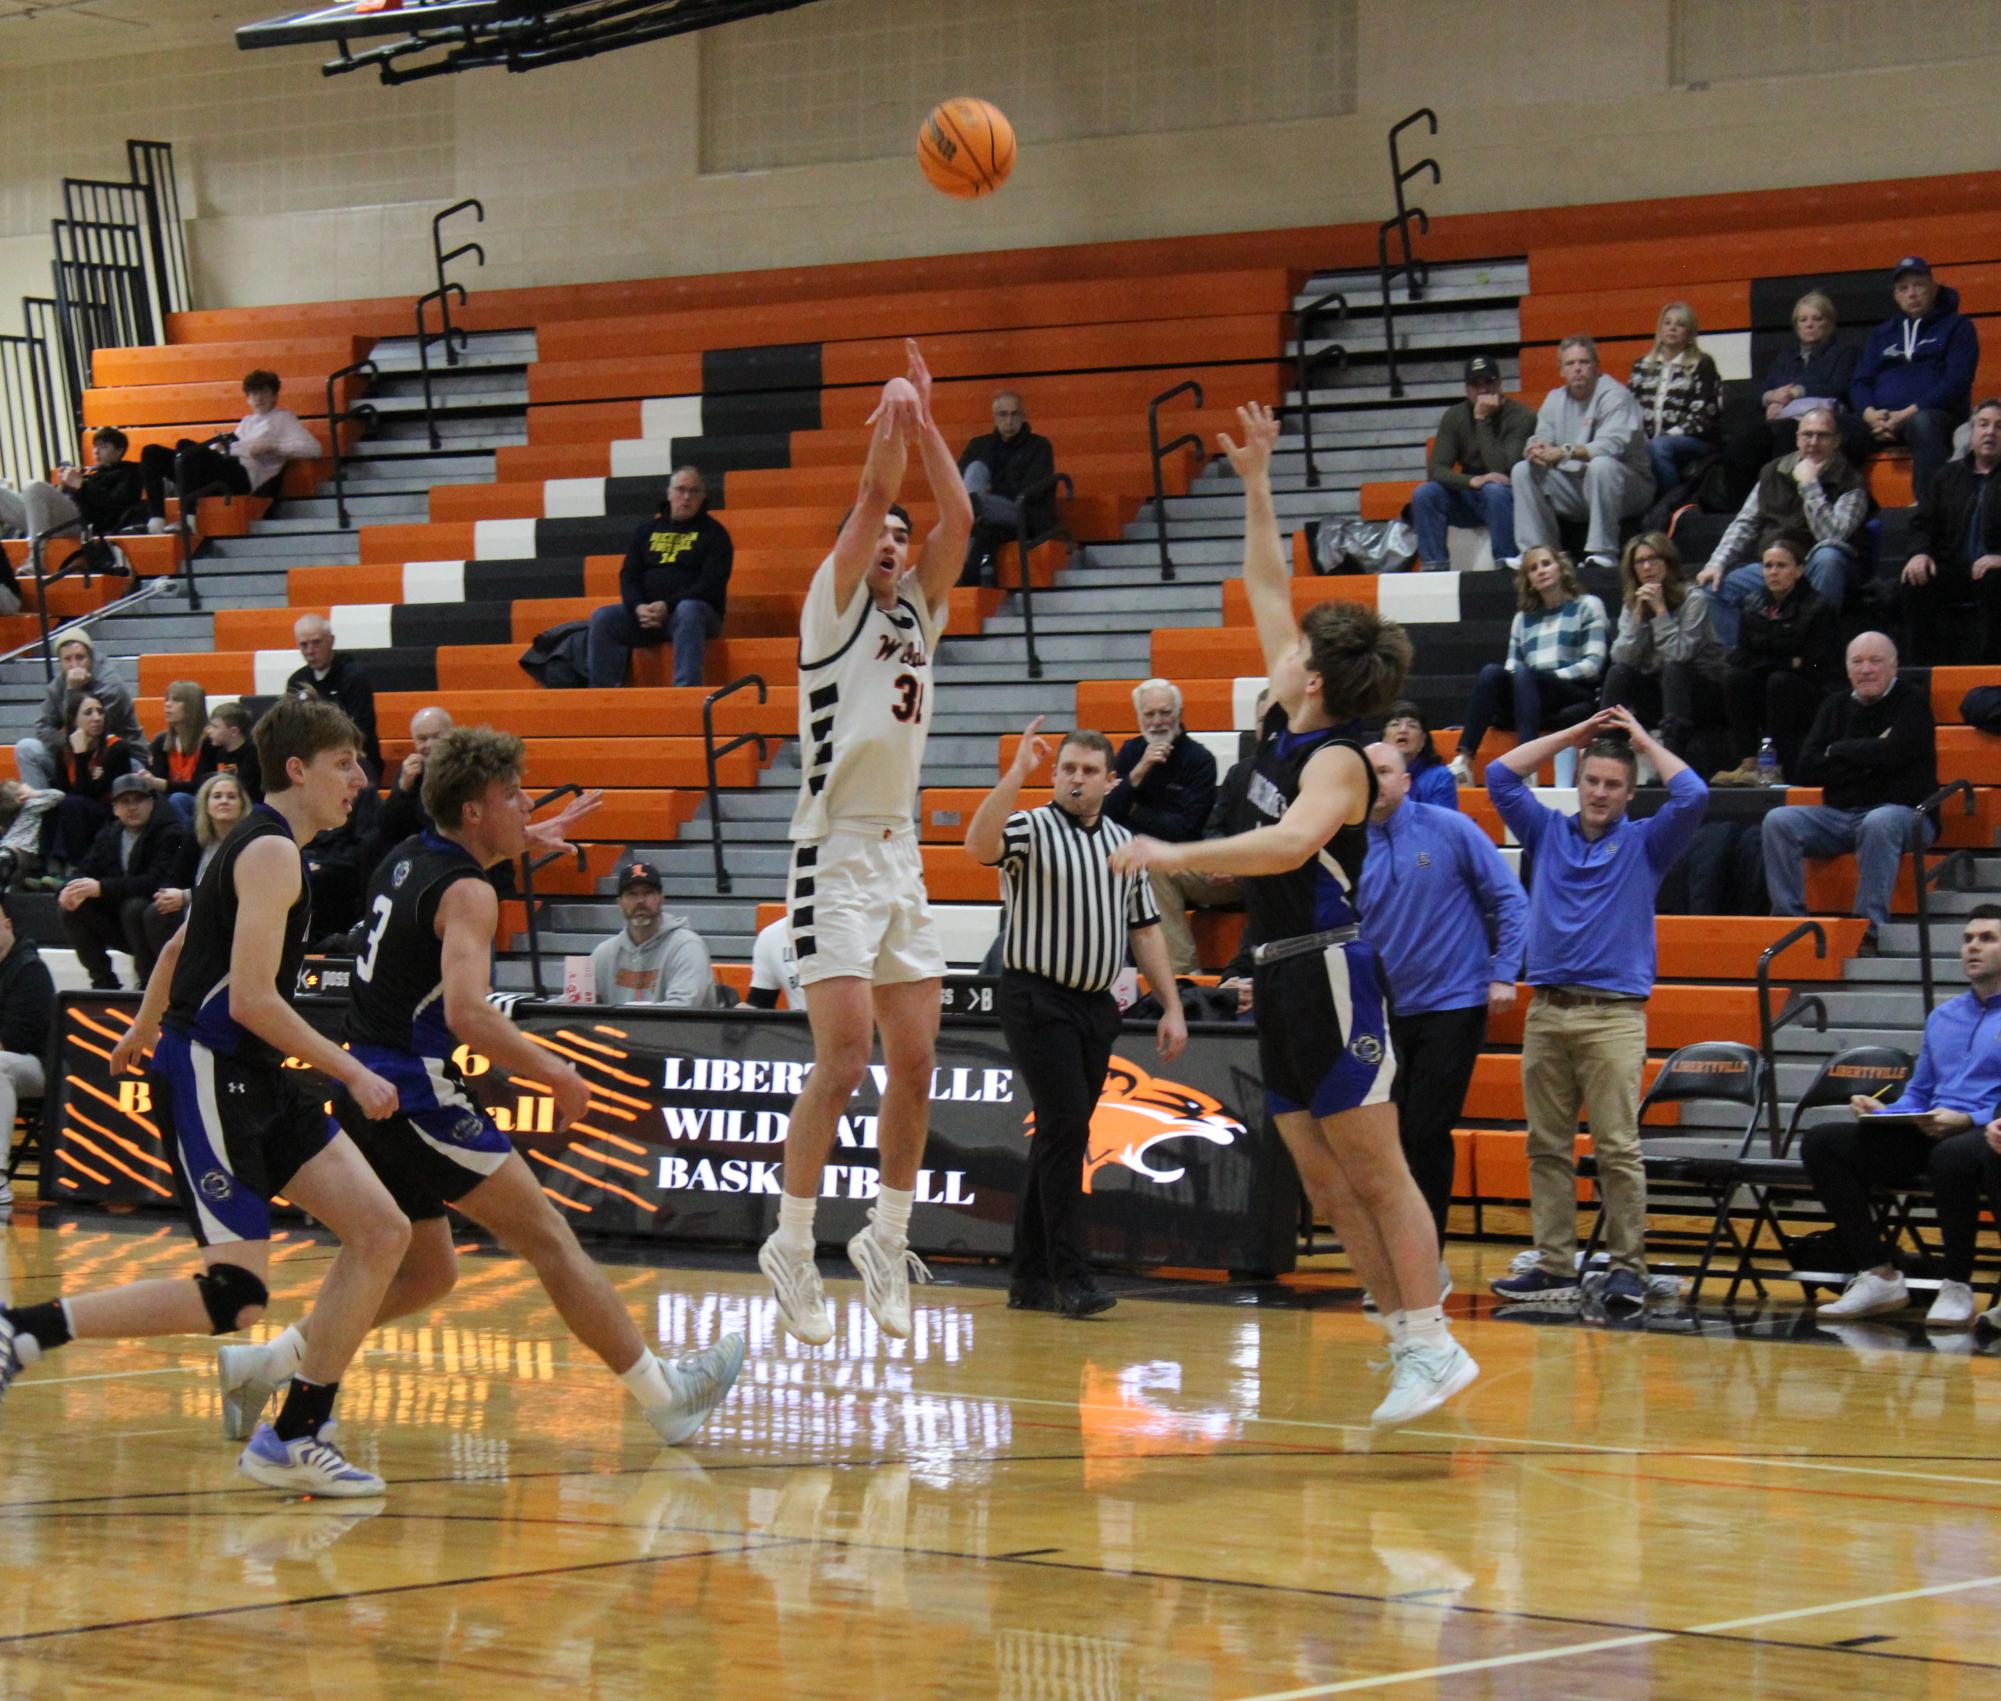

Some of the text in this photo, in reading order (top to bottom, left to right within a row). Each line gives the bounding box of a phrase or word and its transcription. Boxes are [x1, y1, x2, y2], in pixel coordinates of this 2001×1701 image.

[356, 894, 393, 983] 3
[663, 1057, 1013, 1103] LIBERVLLE
[657, 1156, 975, 1205] BASKTBLL
